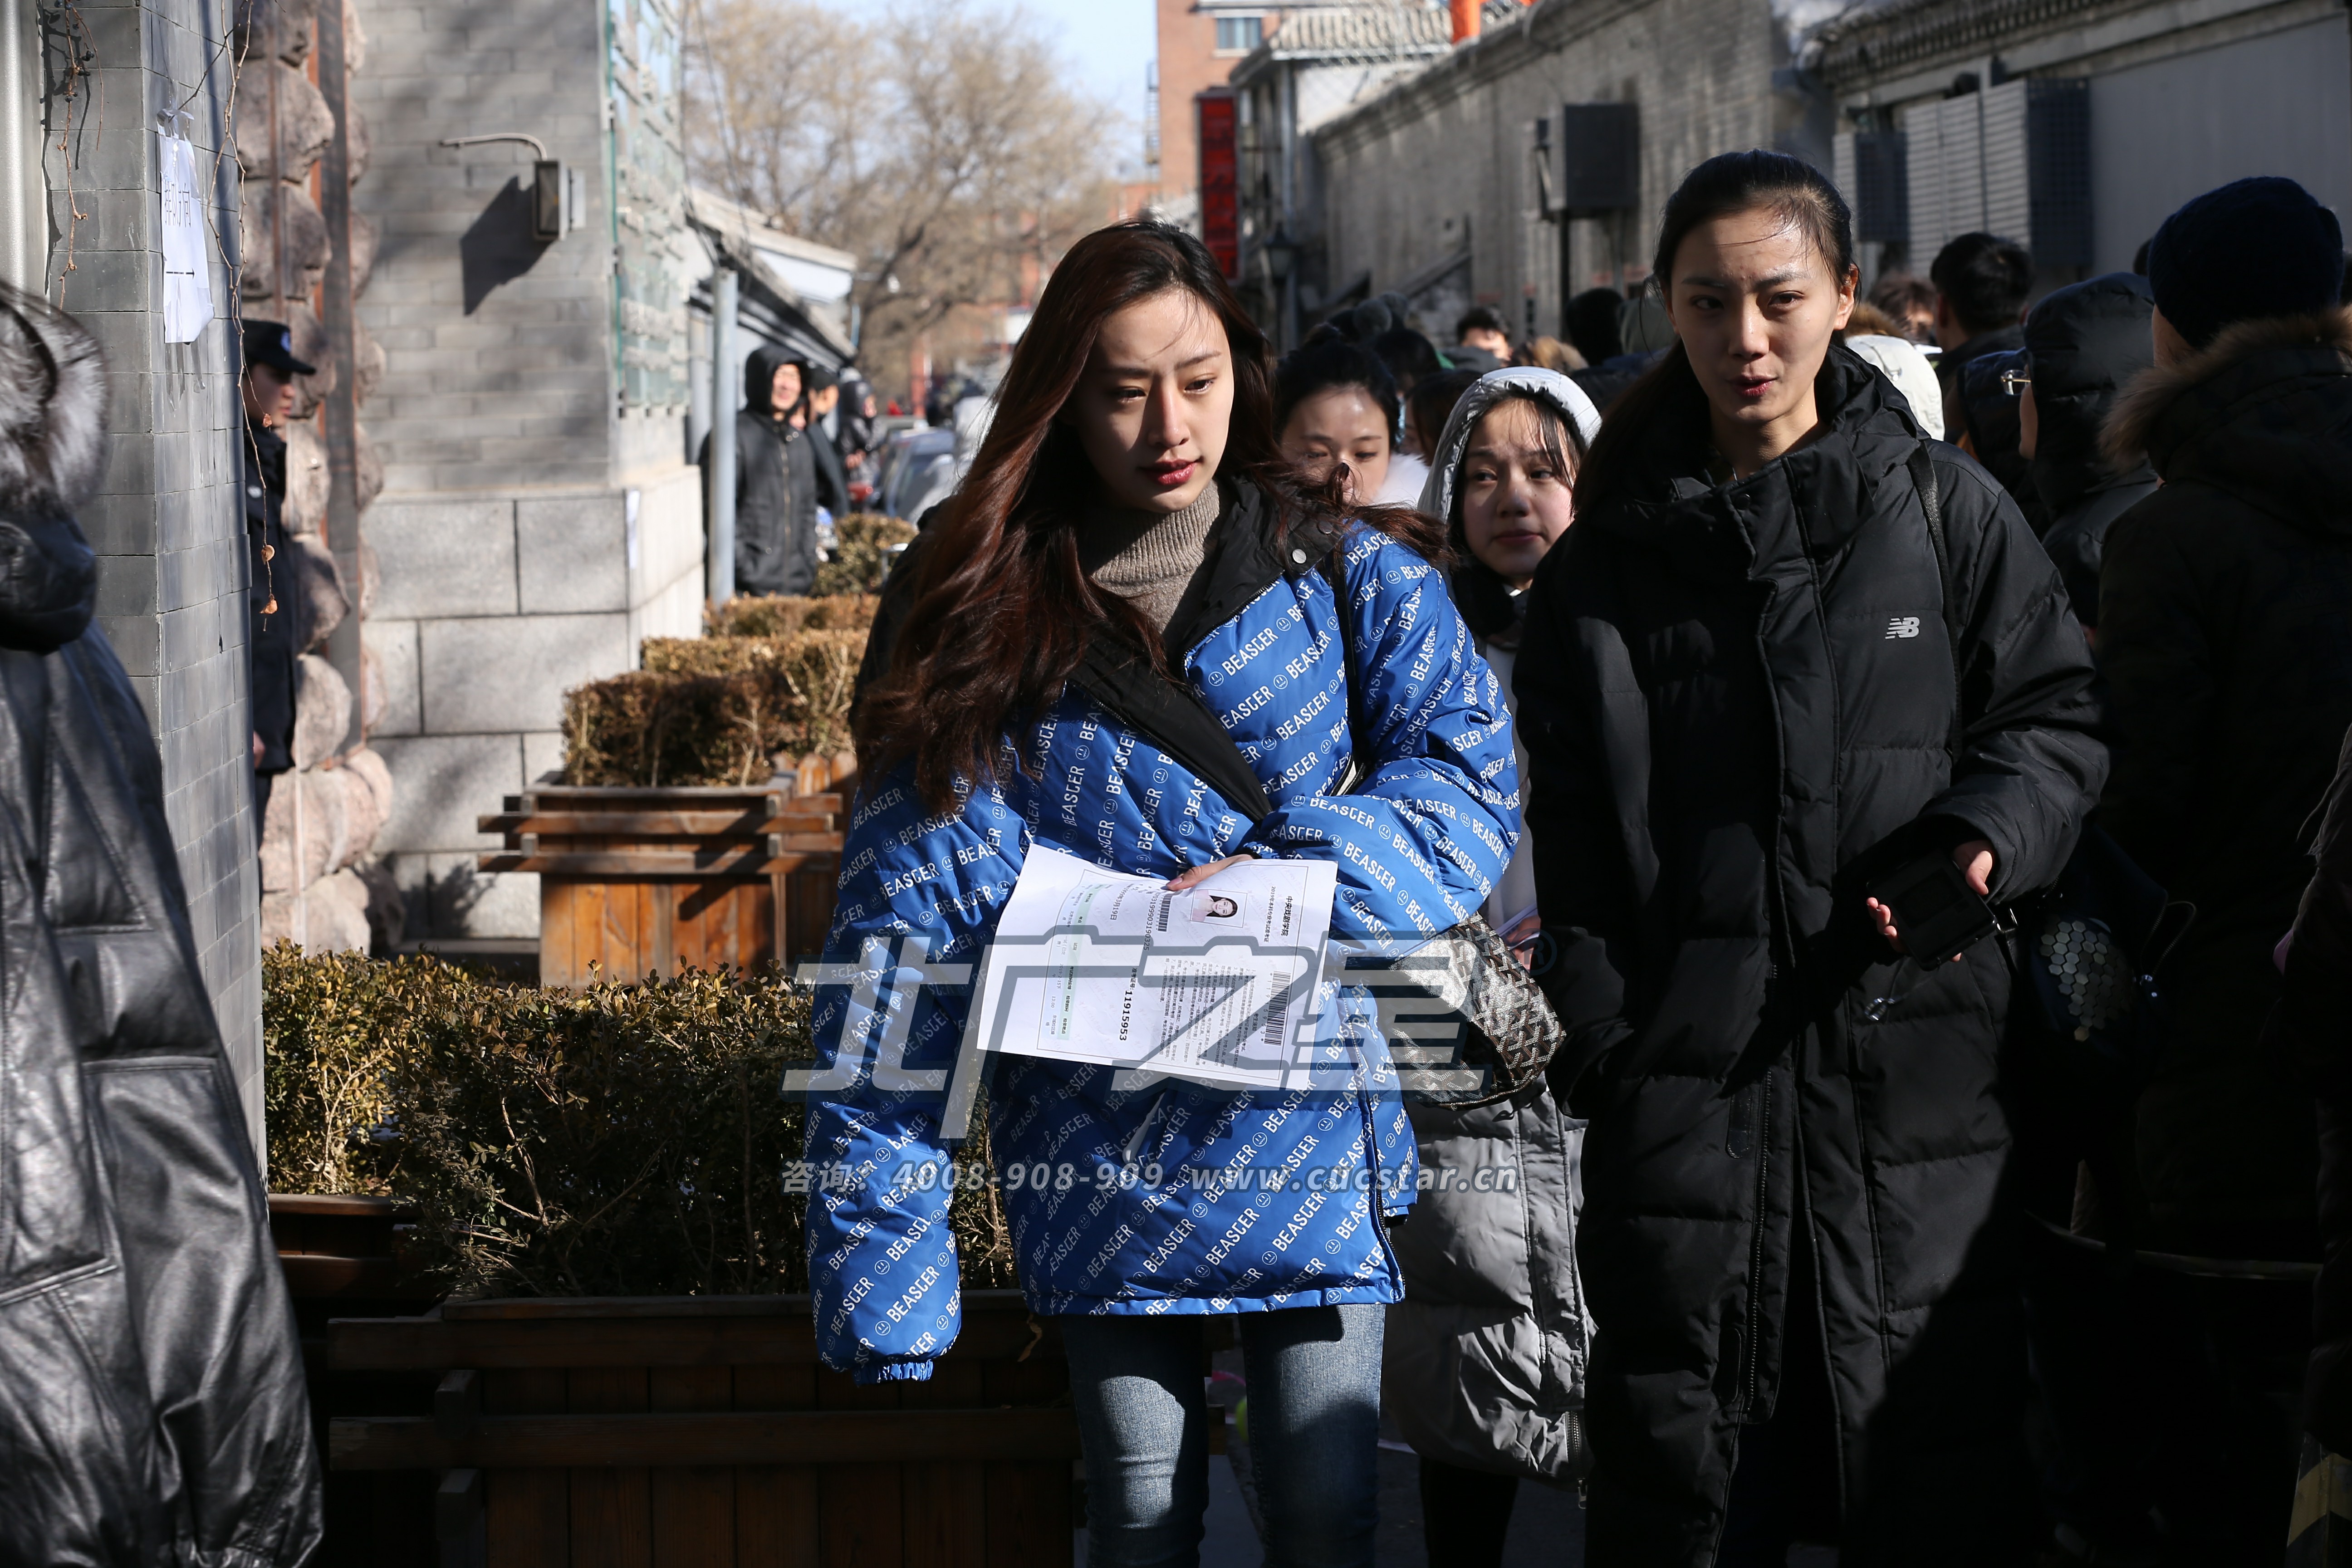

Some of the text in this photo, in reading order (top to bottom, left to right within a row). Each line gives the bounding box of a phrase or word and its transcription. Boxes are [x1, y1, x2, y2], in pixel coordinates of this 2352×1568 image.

[1281, 896, 1293, 936] 中央戏剧学院
[1119, 990, 1132, 1041] 11915953
